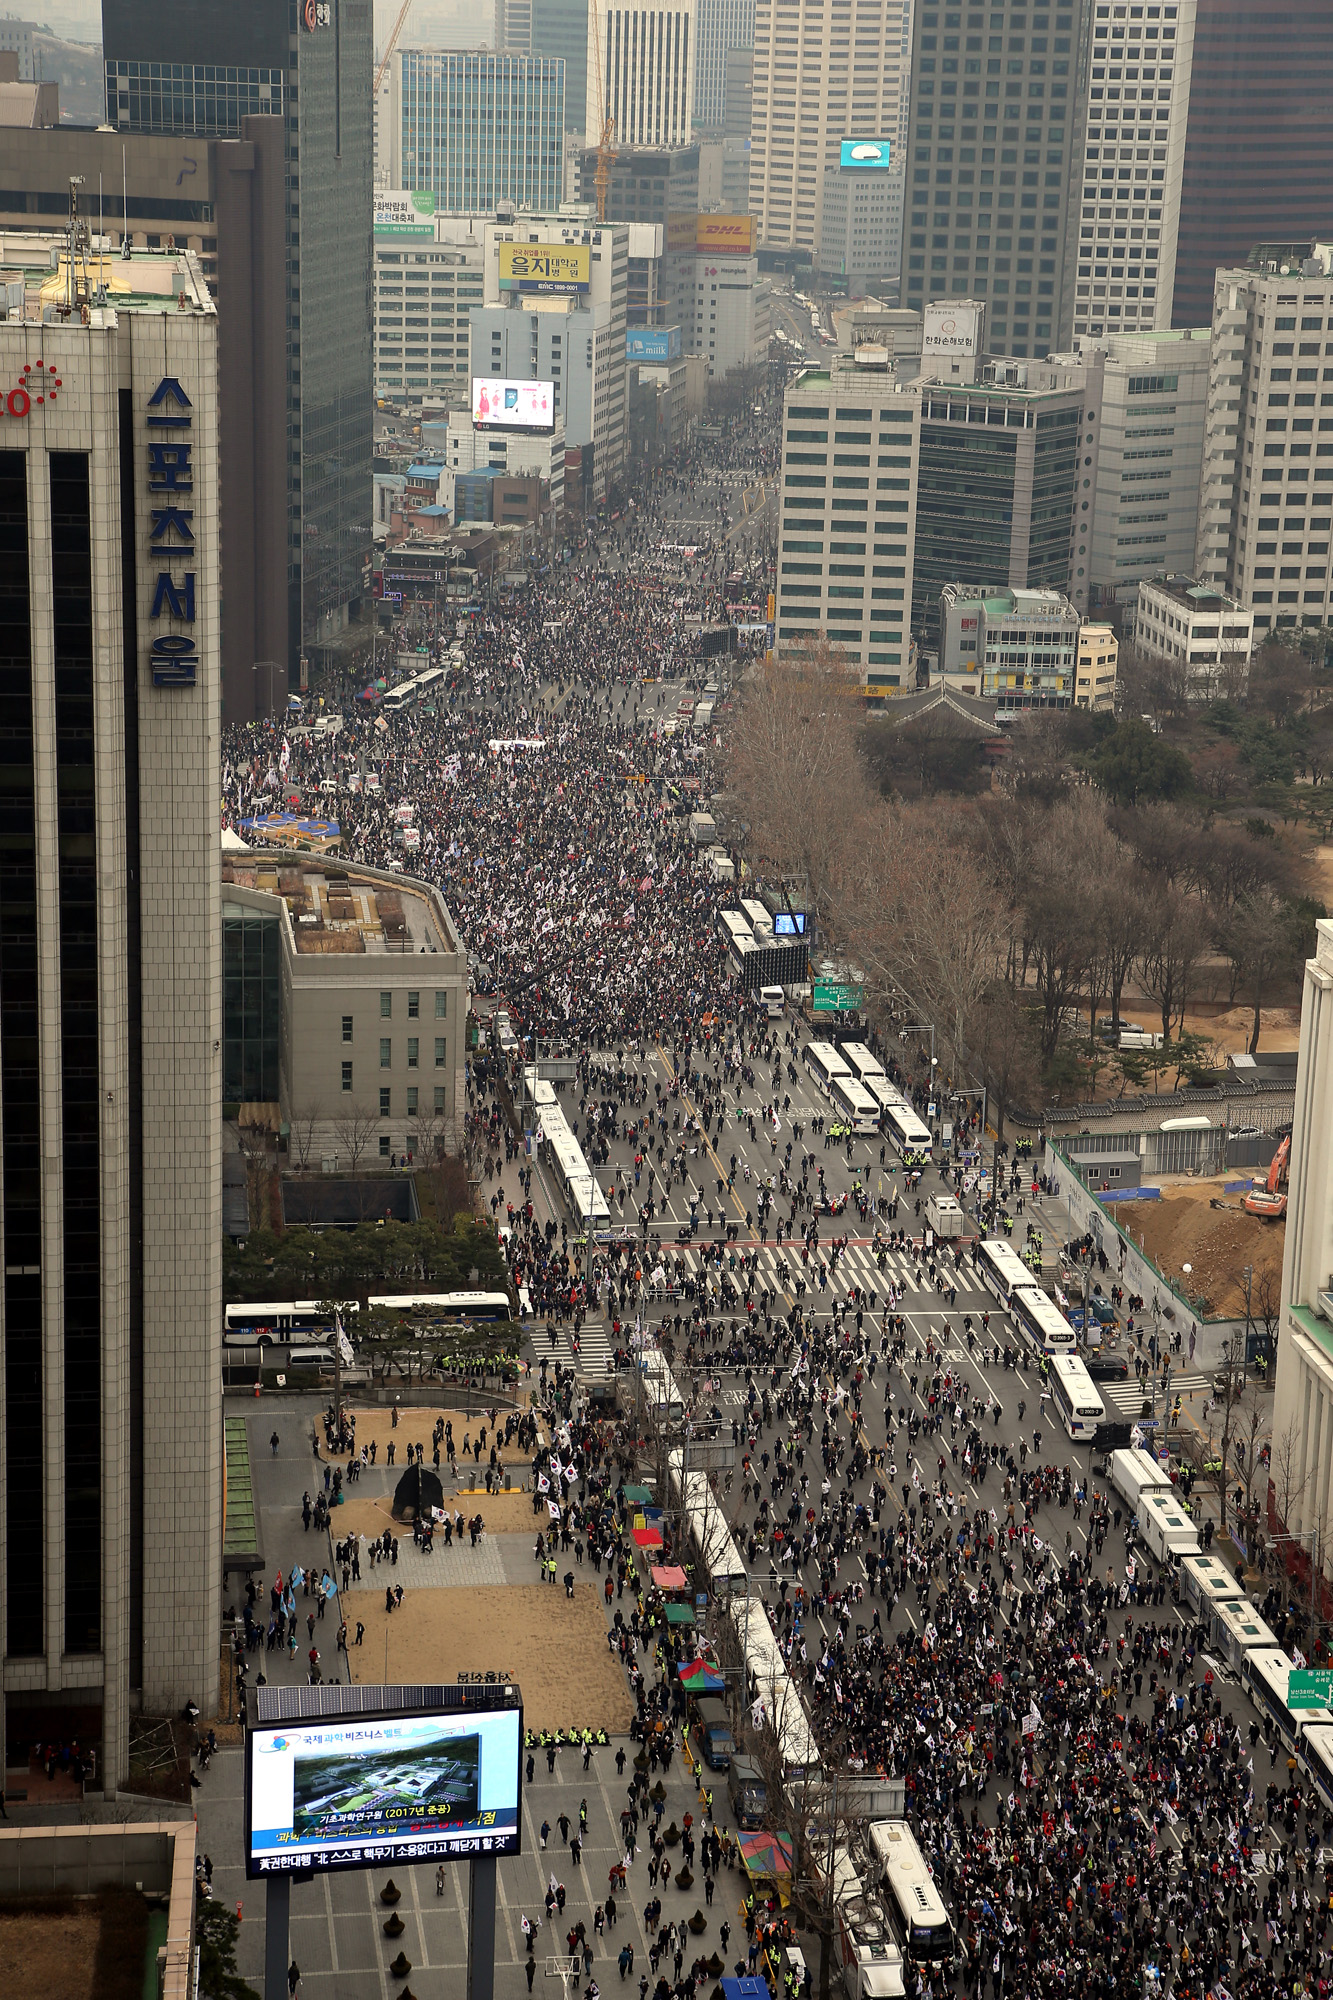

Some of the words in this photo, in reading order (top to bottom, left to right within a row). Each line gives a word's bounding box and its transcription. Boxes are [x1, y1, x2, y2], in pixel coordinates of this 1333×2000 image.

[316, 3, 330, 26] 한화
[705, 225, 744, 235] DHL
[511, 256, 550, 276] 을지
[552, 258, 578, 267] 대학교
[925, 336, 972, 347] 한화손해보험
[147, 376, 201, 687] 스포츠서울
[320, 1811, 383, 1824] 기초과학연구원
[427, 1804, 451, 1815] 준공)
[330, 1849, 362, 1863] 스스로
[363, 1846, 394, 1860] 핵무기
[397, 1842, 447, 1858] 소용없다고
[449, 1838, 480, 1852] 깨닫게
[482, 1836, 493, 1849] 할
